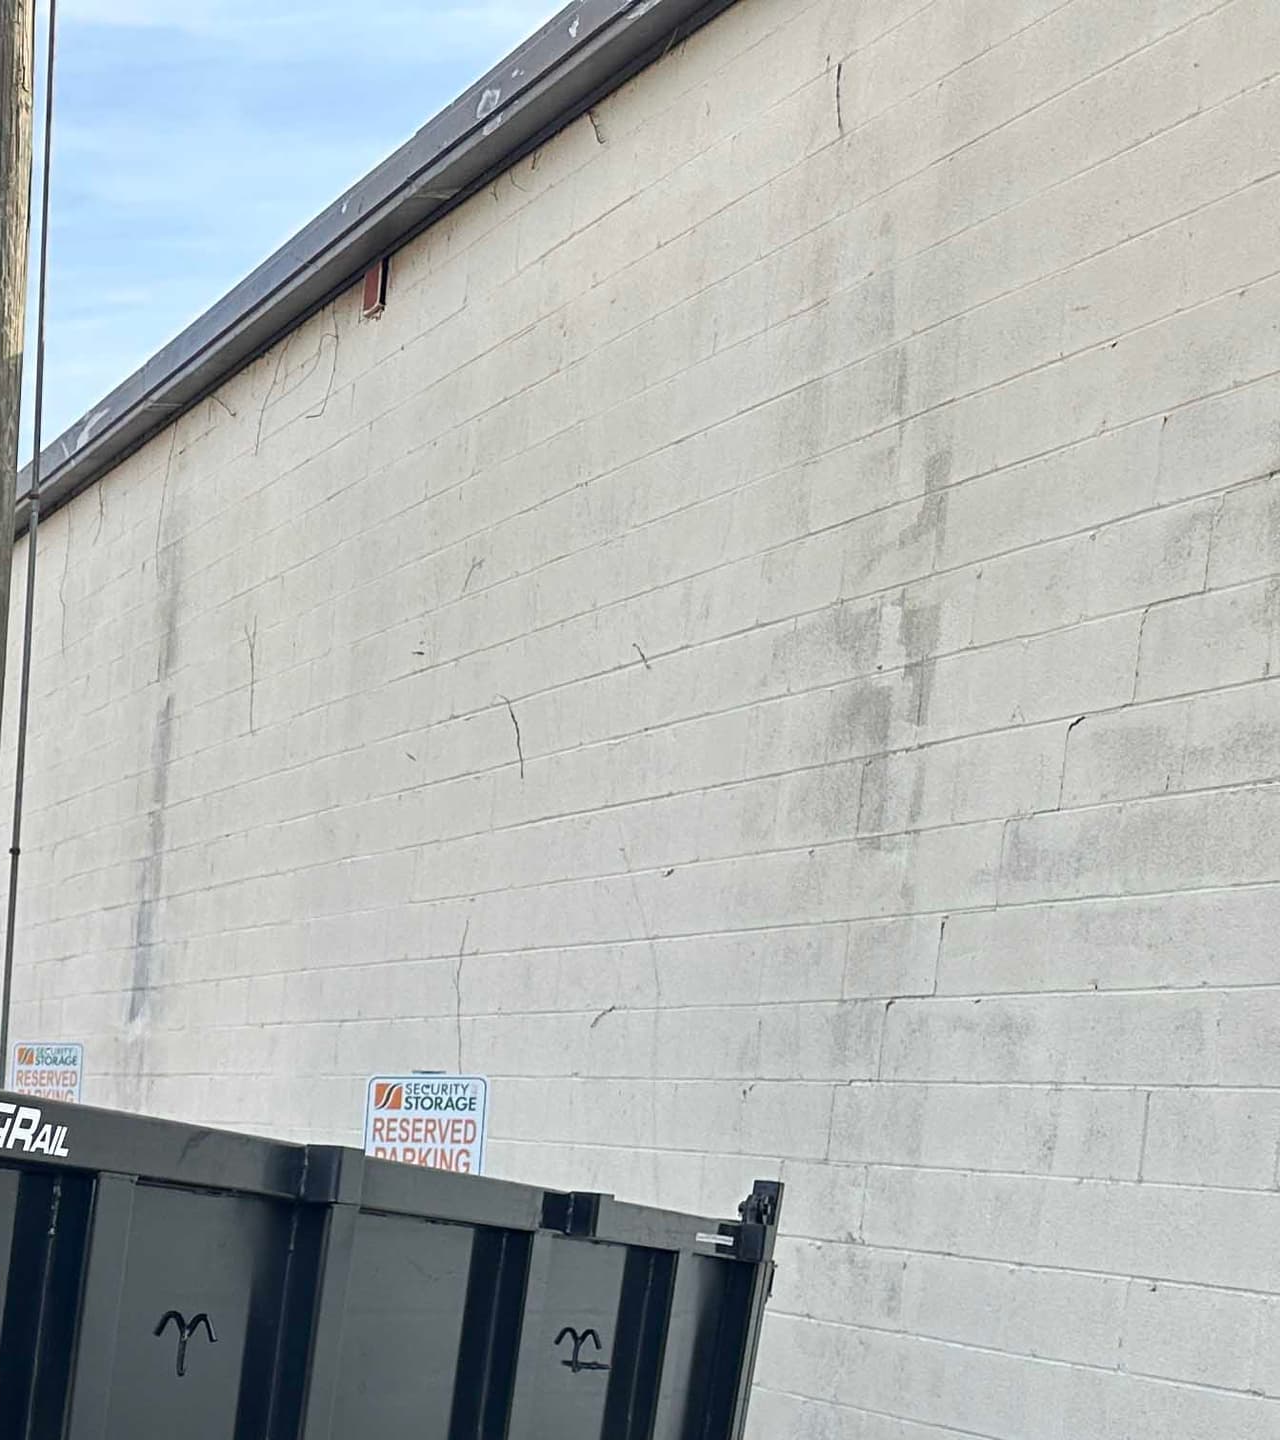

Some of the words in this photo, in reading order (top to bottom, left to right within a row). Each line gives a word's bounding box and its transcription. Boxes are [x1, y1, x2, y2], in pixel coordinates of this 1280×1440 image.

[35, 1055, 78, 1066] STORAGE
[15, 1070, 78, 1087] RESERVED
[404, 1083, 470, 1096] SECURITY
[403, 1096, 477, 1112] STORAGE
[372, 1117, 477, 1144] RESERVED
